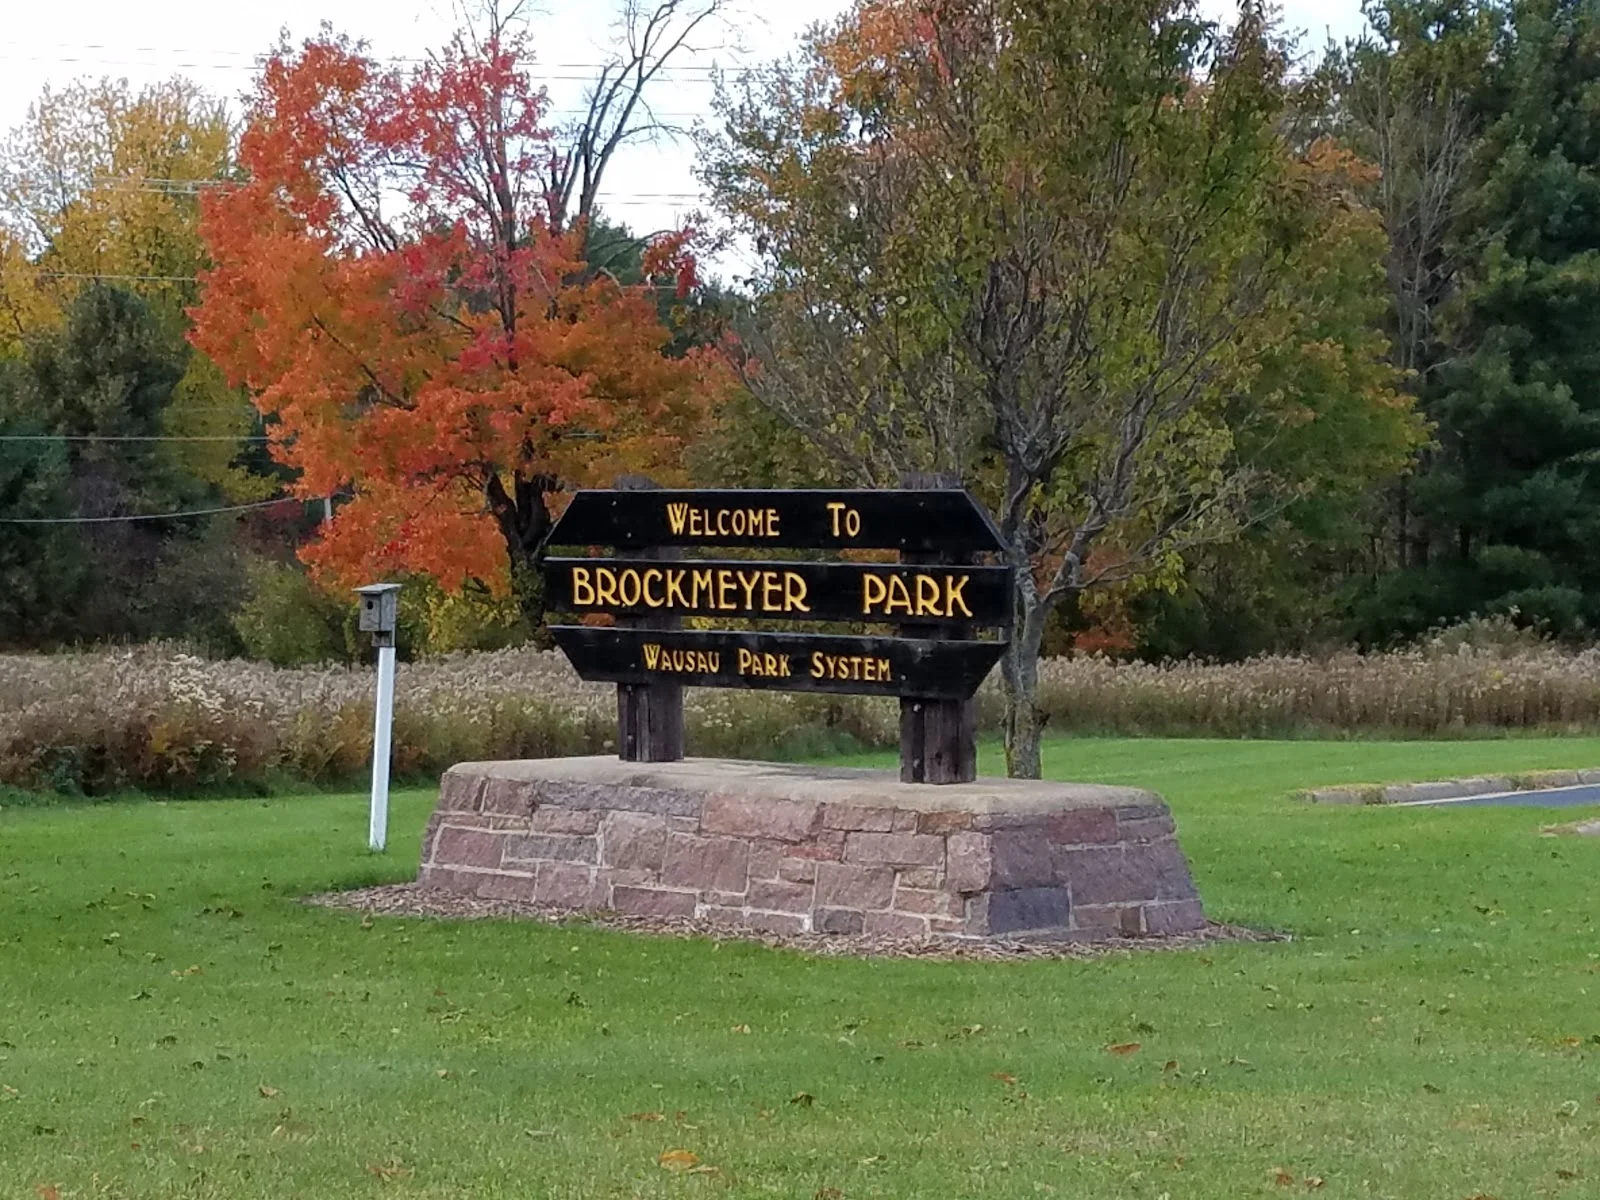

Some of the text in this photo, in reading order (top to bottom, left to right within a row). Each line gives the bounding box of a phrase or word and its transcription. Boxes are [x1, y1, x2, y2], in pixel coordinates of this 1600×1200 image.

[666, 502, 861, 538] WELCOME TO
[572, 567, 973, 618] BROCKMEYER PARK
[642, 643, 892, 681] WAUSAU PARK SYSTEM
